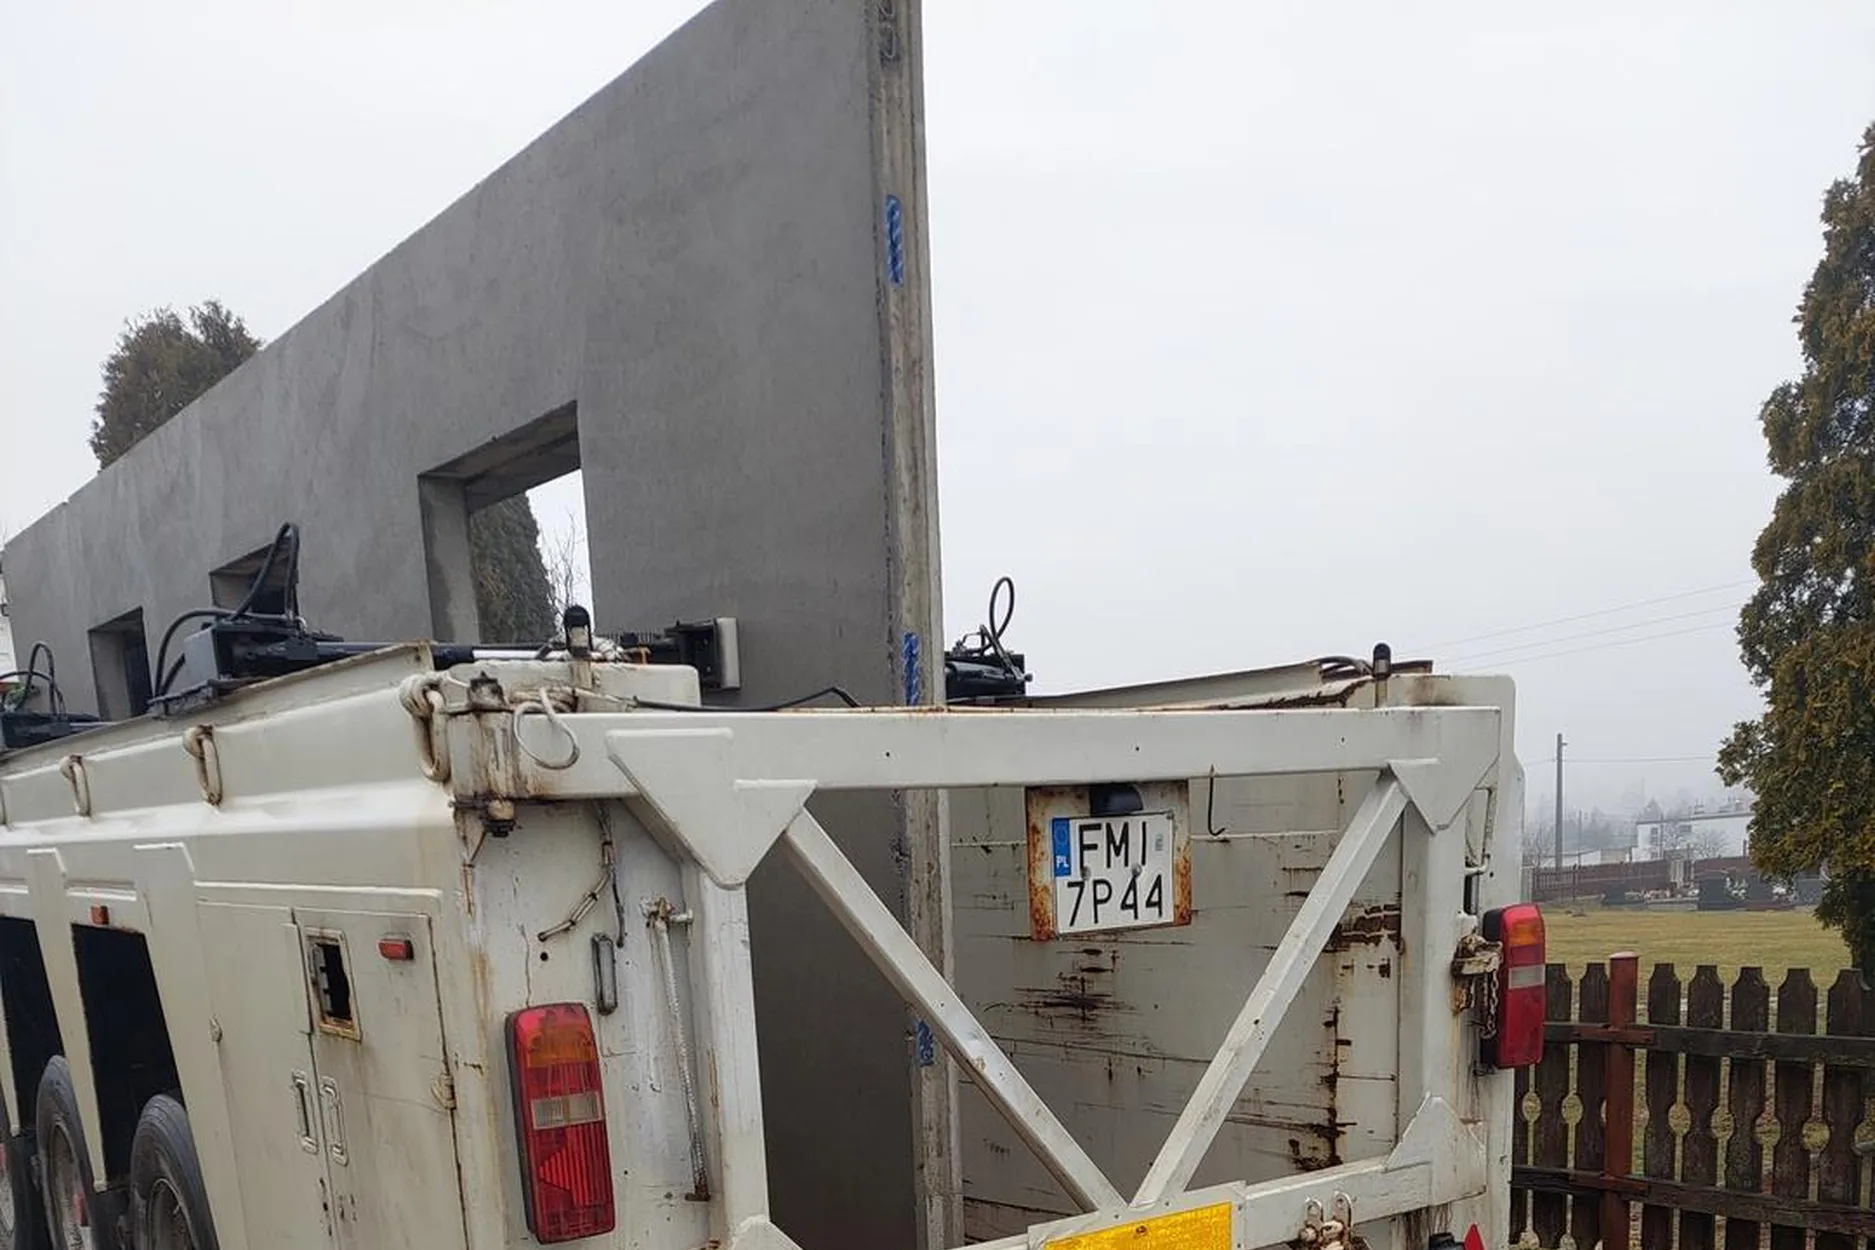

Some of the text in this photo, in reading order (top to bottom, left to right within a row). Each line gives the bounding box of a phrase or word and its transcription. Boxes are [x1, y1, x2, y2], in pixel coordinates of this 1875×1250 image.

[1056, 855, 1070, 868] PL
[1079, 821, 1147, 870] FMI
[1067, 874, 1164, 927] 7P44
